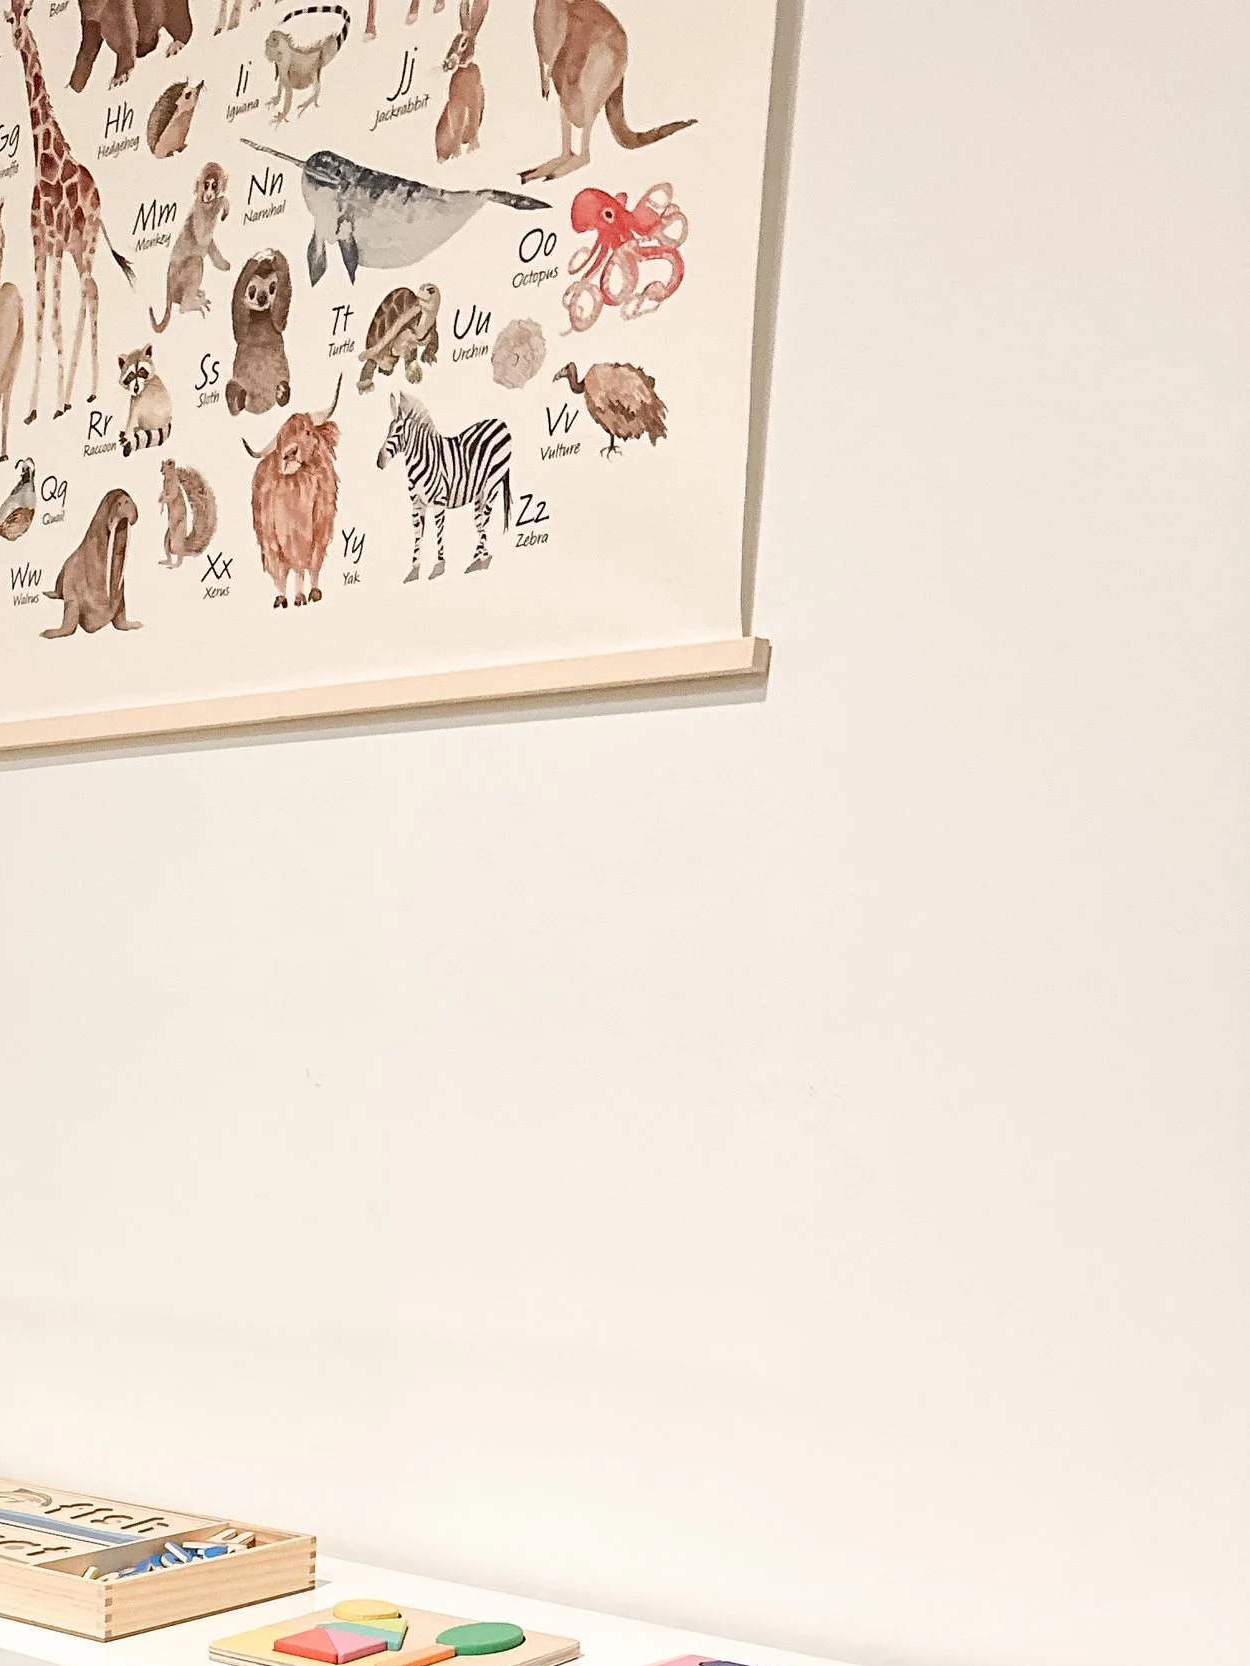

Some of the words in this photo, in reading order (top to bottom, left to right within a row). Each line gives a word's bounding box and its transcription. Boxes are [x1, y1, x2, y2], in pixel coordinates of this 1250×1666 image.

[49, 1, 68, 17] Bear
[235, 61, 253, 97] Ii
[387, 48, 418, 102] Jj
[104, 102, 134, 139] Hh
[226, 97, 260, 120] Iguana
[370, 93, 431, 131] Jackrabbit
[97, 135, 140, 160] Hedgehog
[248, 167, 284, 205] Nn
[133, 200, 177, 235] Mm
[243, 200, 286, 225] Narwhal
[135, 233, 171, 253] Monkey
[519, 229, 556, 263] Oo
[512, 265, 559, 290] Octopus
[331, 305, 354, 337] Tt
[453, 305, 491, 341] Uu
[328, 339, 355, 359] Turtle
[452, 344, 489, 362] Urchin
[195, 354, 221, 390] Ss
[196, 390, 220, 408] Sloth
[87, 411, 112, 439] Rr
[546, 404, 578, 436] Vv
[83, 441, 117, 459] Raccoon
[540, 442, 581, 461] Vulture
[41, 475, 68, 508] Qq
[42, 509, 66, 525] Quail
[516, 494, 550, 527] Zz
[342, 527, 365, 564] Yy
[516, 531, 549, 548] Zebra
[10, 562, 42, 590] Ww
[200, 552, 232, 583] Xx
[342, 571, 361, 585] Yak
[13, 591, 40, 607] Walrus
[203, 586, 230, 599] Xerus
